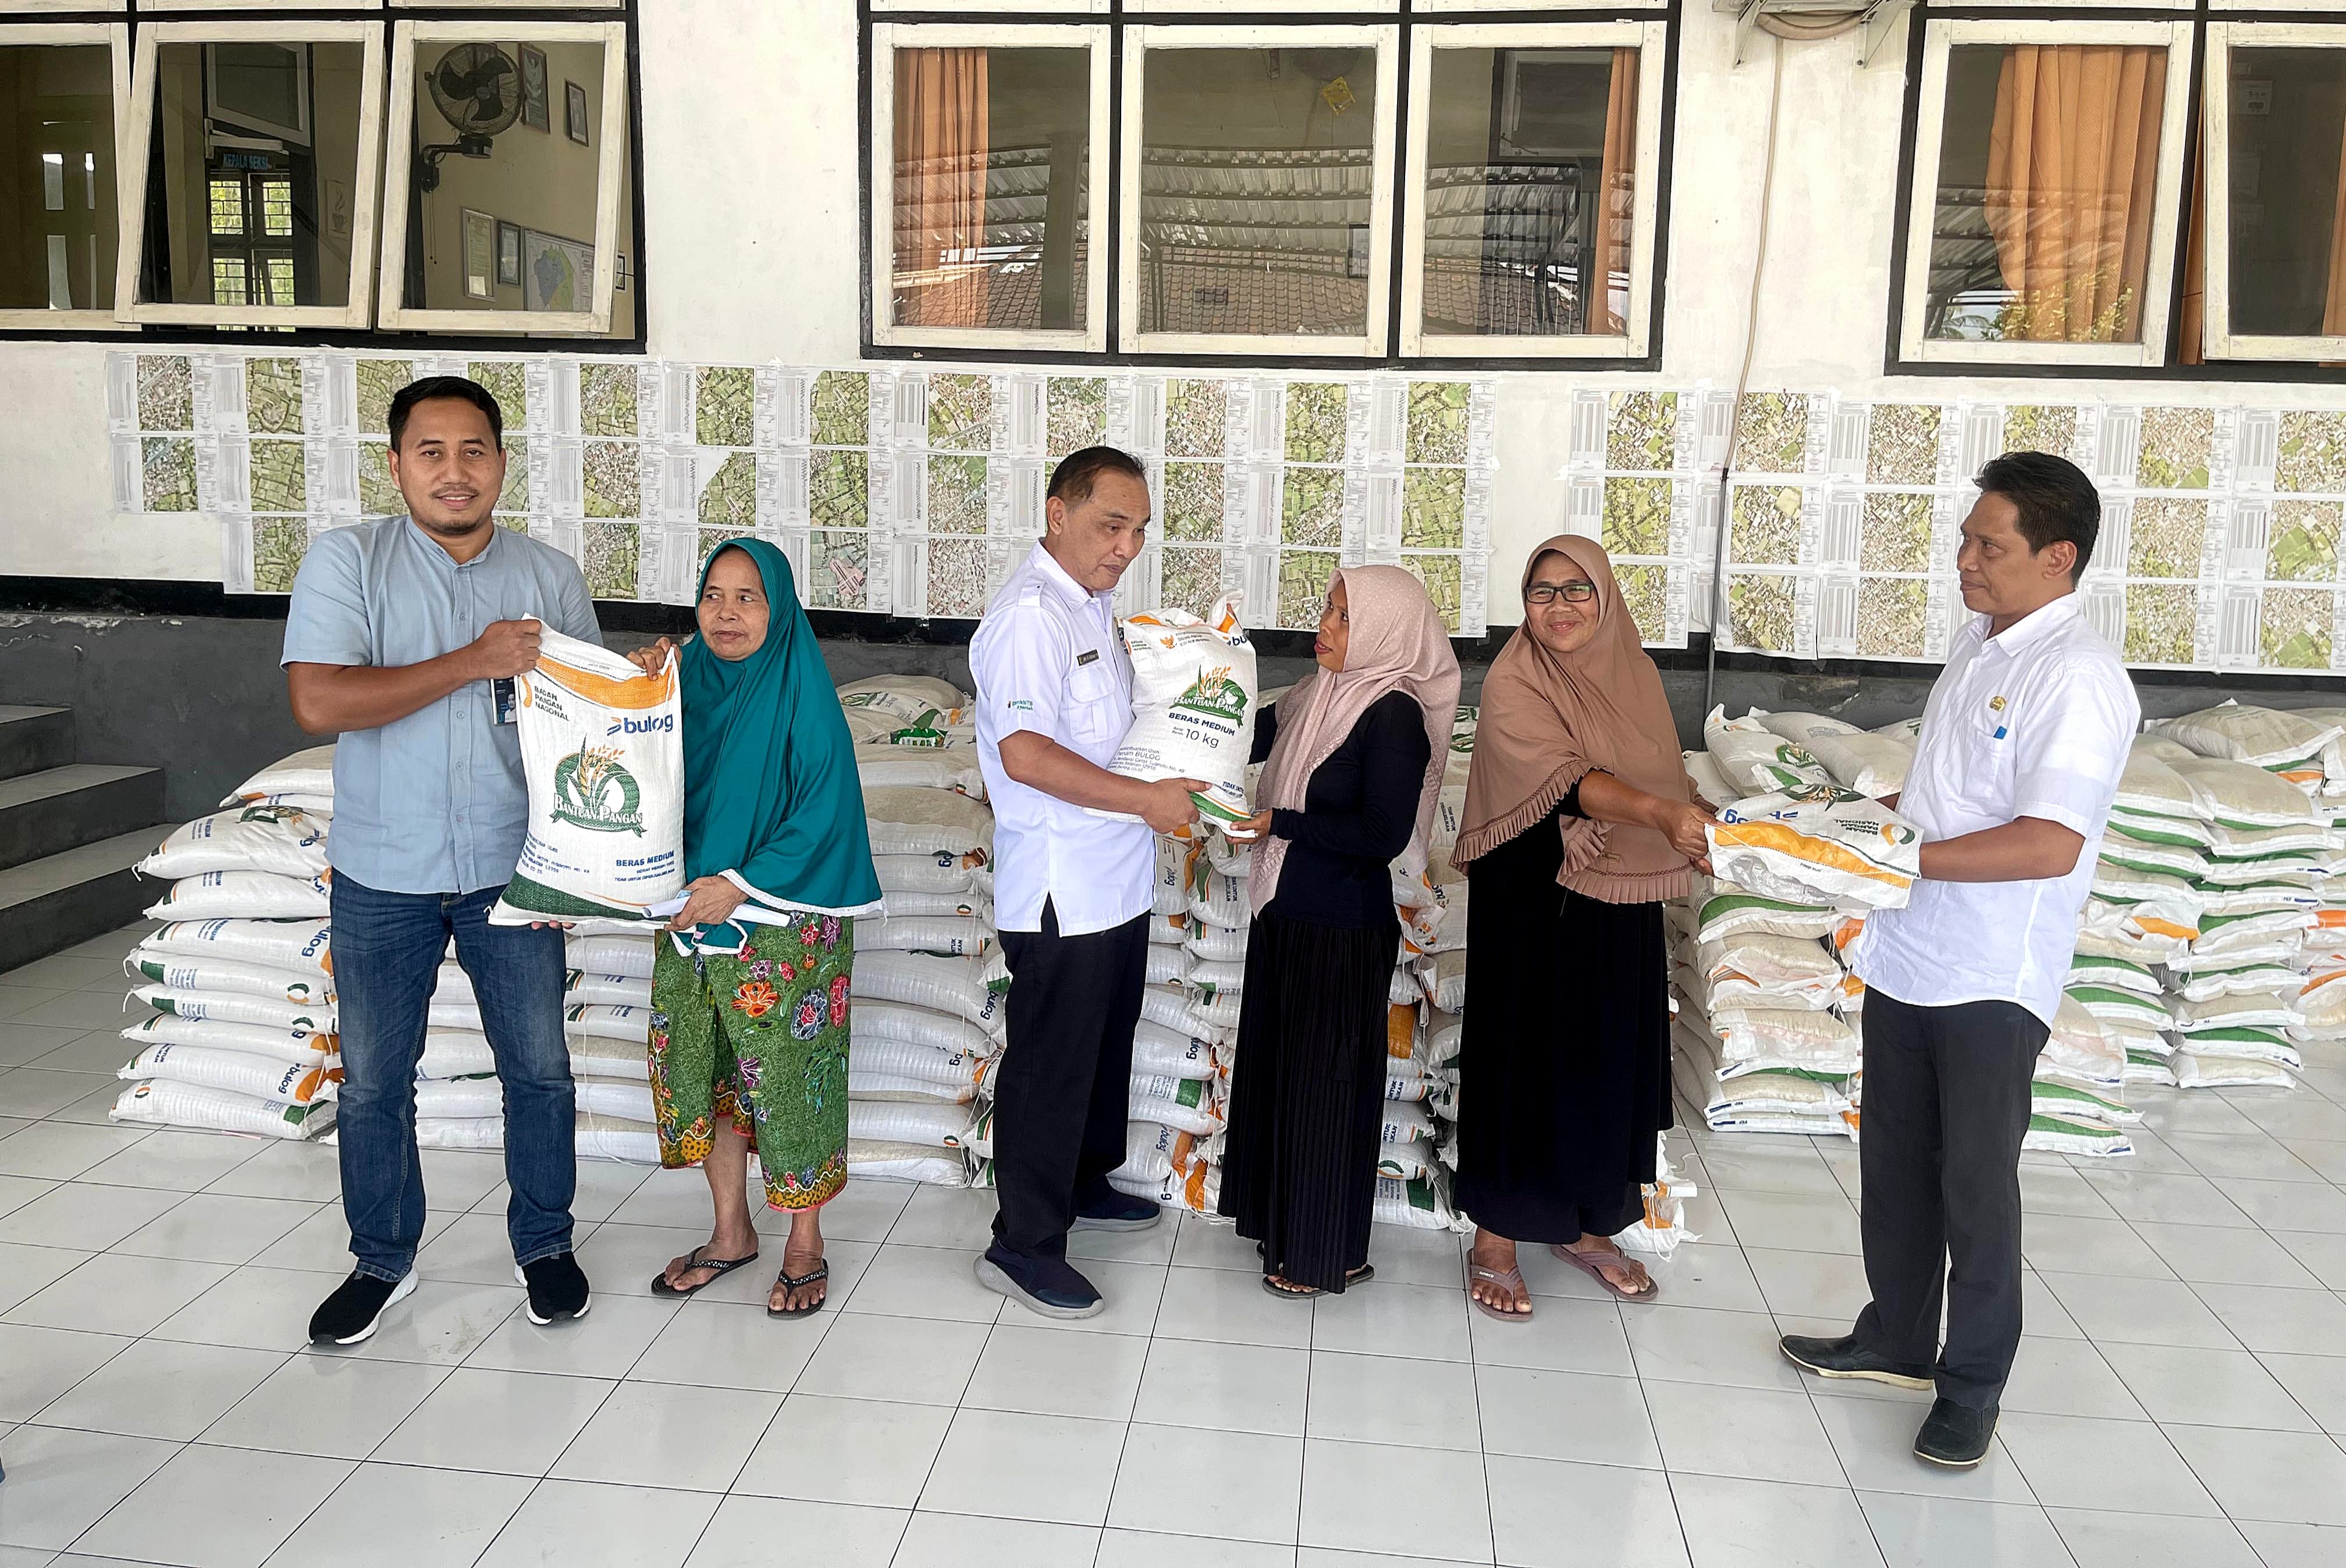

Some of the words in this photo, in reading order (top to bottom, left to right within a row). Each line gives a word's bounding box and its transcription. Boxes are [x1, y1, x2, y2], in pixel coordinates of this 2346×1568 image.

[223, 154, 247, 168] KEPALA
[249, 155, 268, 170] SEKSI
[535, 685, 557, 701] BADAN
[624, 714, 673, 734] bulog
[1168, 712, 1200, 724] BERAS
[1201, 720, 1235, 736] MEDIUM
[1186, 728, 1200, 740] 10
[1202, 733, 1219, 748] kg
[1135, 751, 1161, 760] BULOG
[1222, 781, 1236, 790] TIDAK
[554, 792, 598, 820] BANTUAN
[599, 804, 643, 824] PANGAN
[1846, 827, 1878, 835] BADAN
[647, 850, 674, 864] MEDIUM
[980, 990, 999, 1021] bulog
[278, 1066, 301, 1094] bulog
